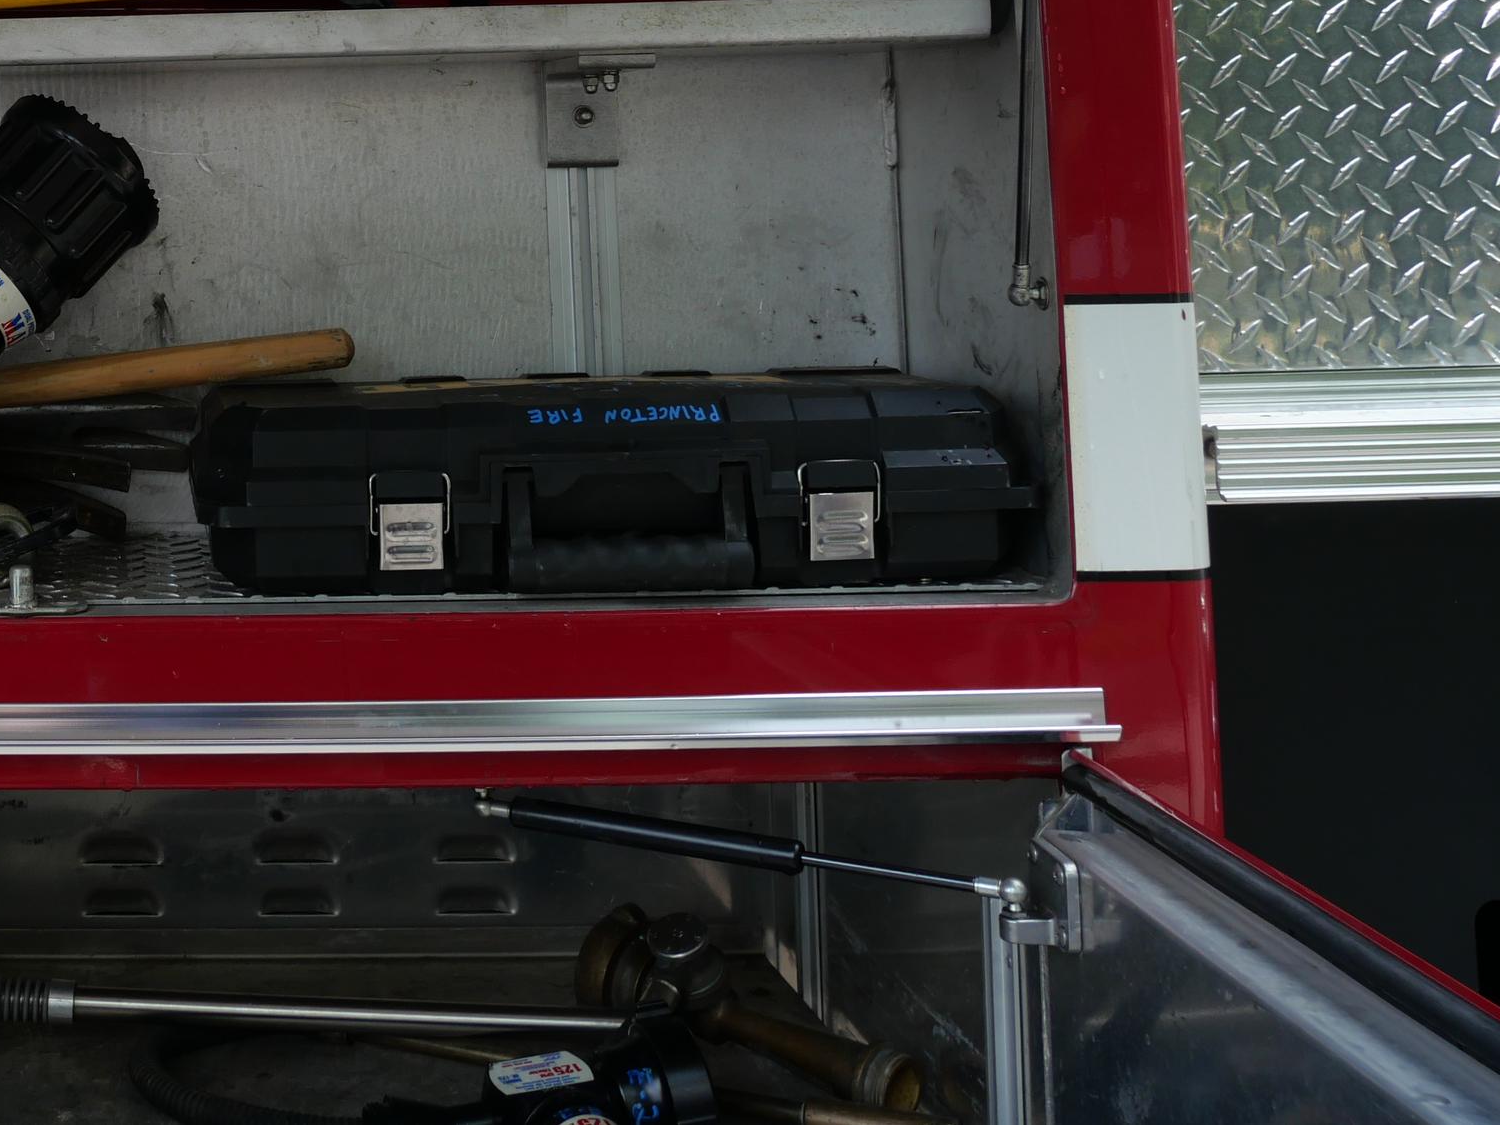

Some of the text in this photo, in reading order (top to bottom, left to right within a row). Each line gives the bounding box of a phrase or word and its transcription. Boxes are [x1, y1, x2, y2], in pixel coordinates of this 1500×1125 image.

[526, 403, 722, 424] PRINCETON FIRE
[552, 1063, 583, 1076] 125
